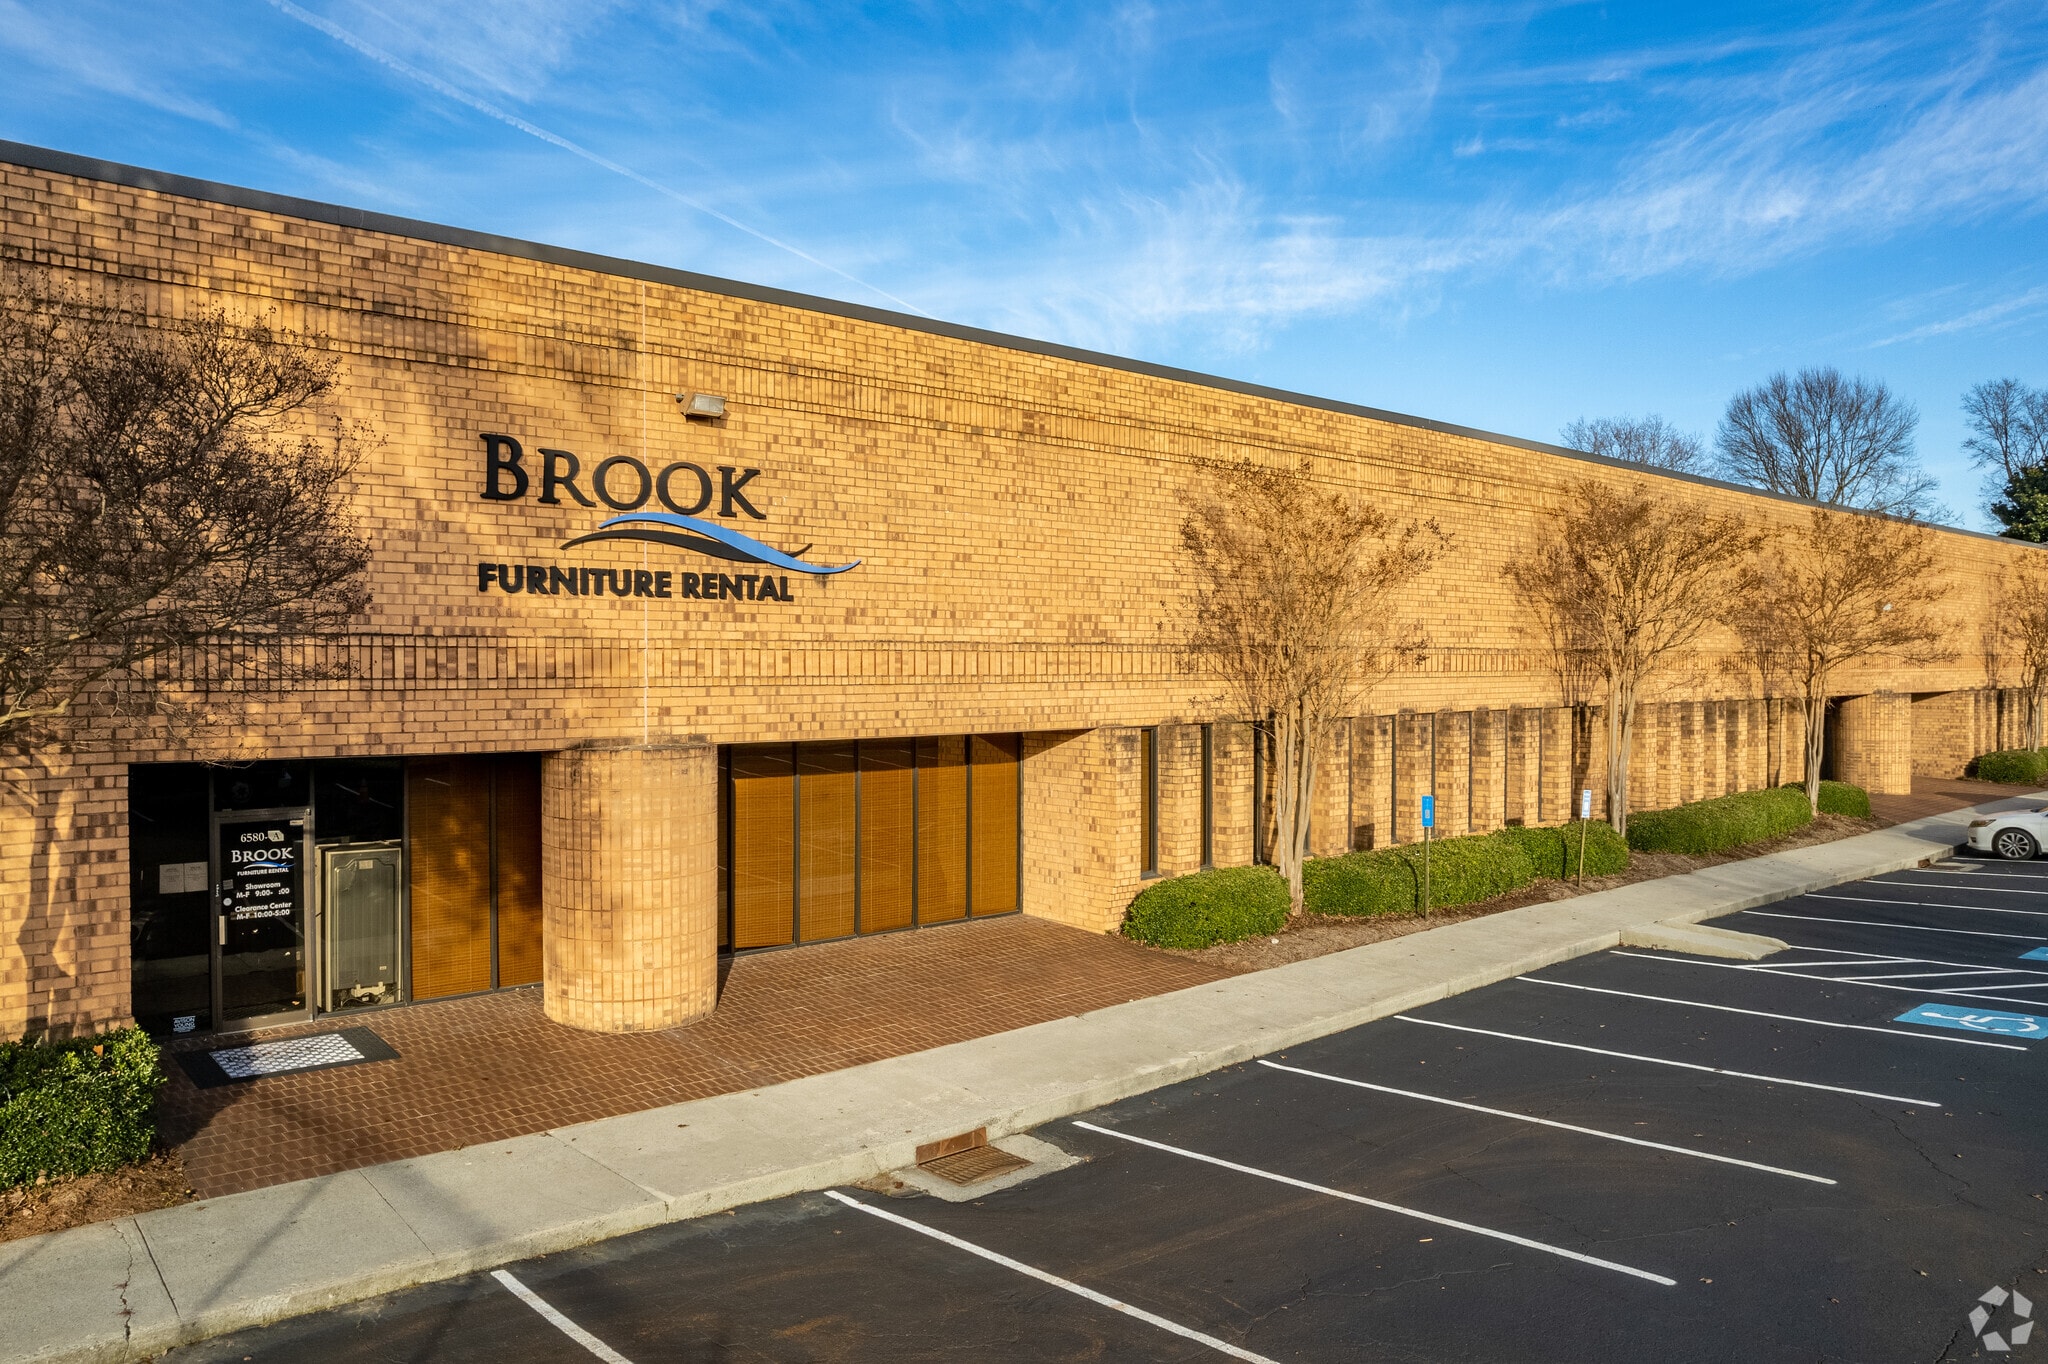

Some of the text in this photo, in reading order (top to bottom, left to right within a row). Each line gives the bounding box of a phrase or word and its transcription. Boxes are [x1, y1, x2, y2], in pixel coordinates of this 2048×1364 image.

[479, 432, 767, 520] BROOK
[478, 562, 795, 602] FURNITURE RENTAL
[231, 847, 294, 863] BROOK
[237, 869, 268, 877] FURNITURE
[245, 882, 281, 890] Showroom
[235, 904, 268, 913] Clearance
[254, 909, 290, 918] 10:00-5:00
